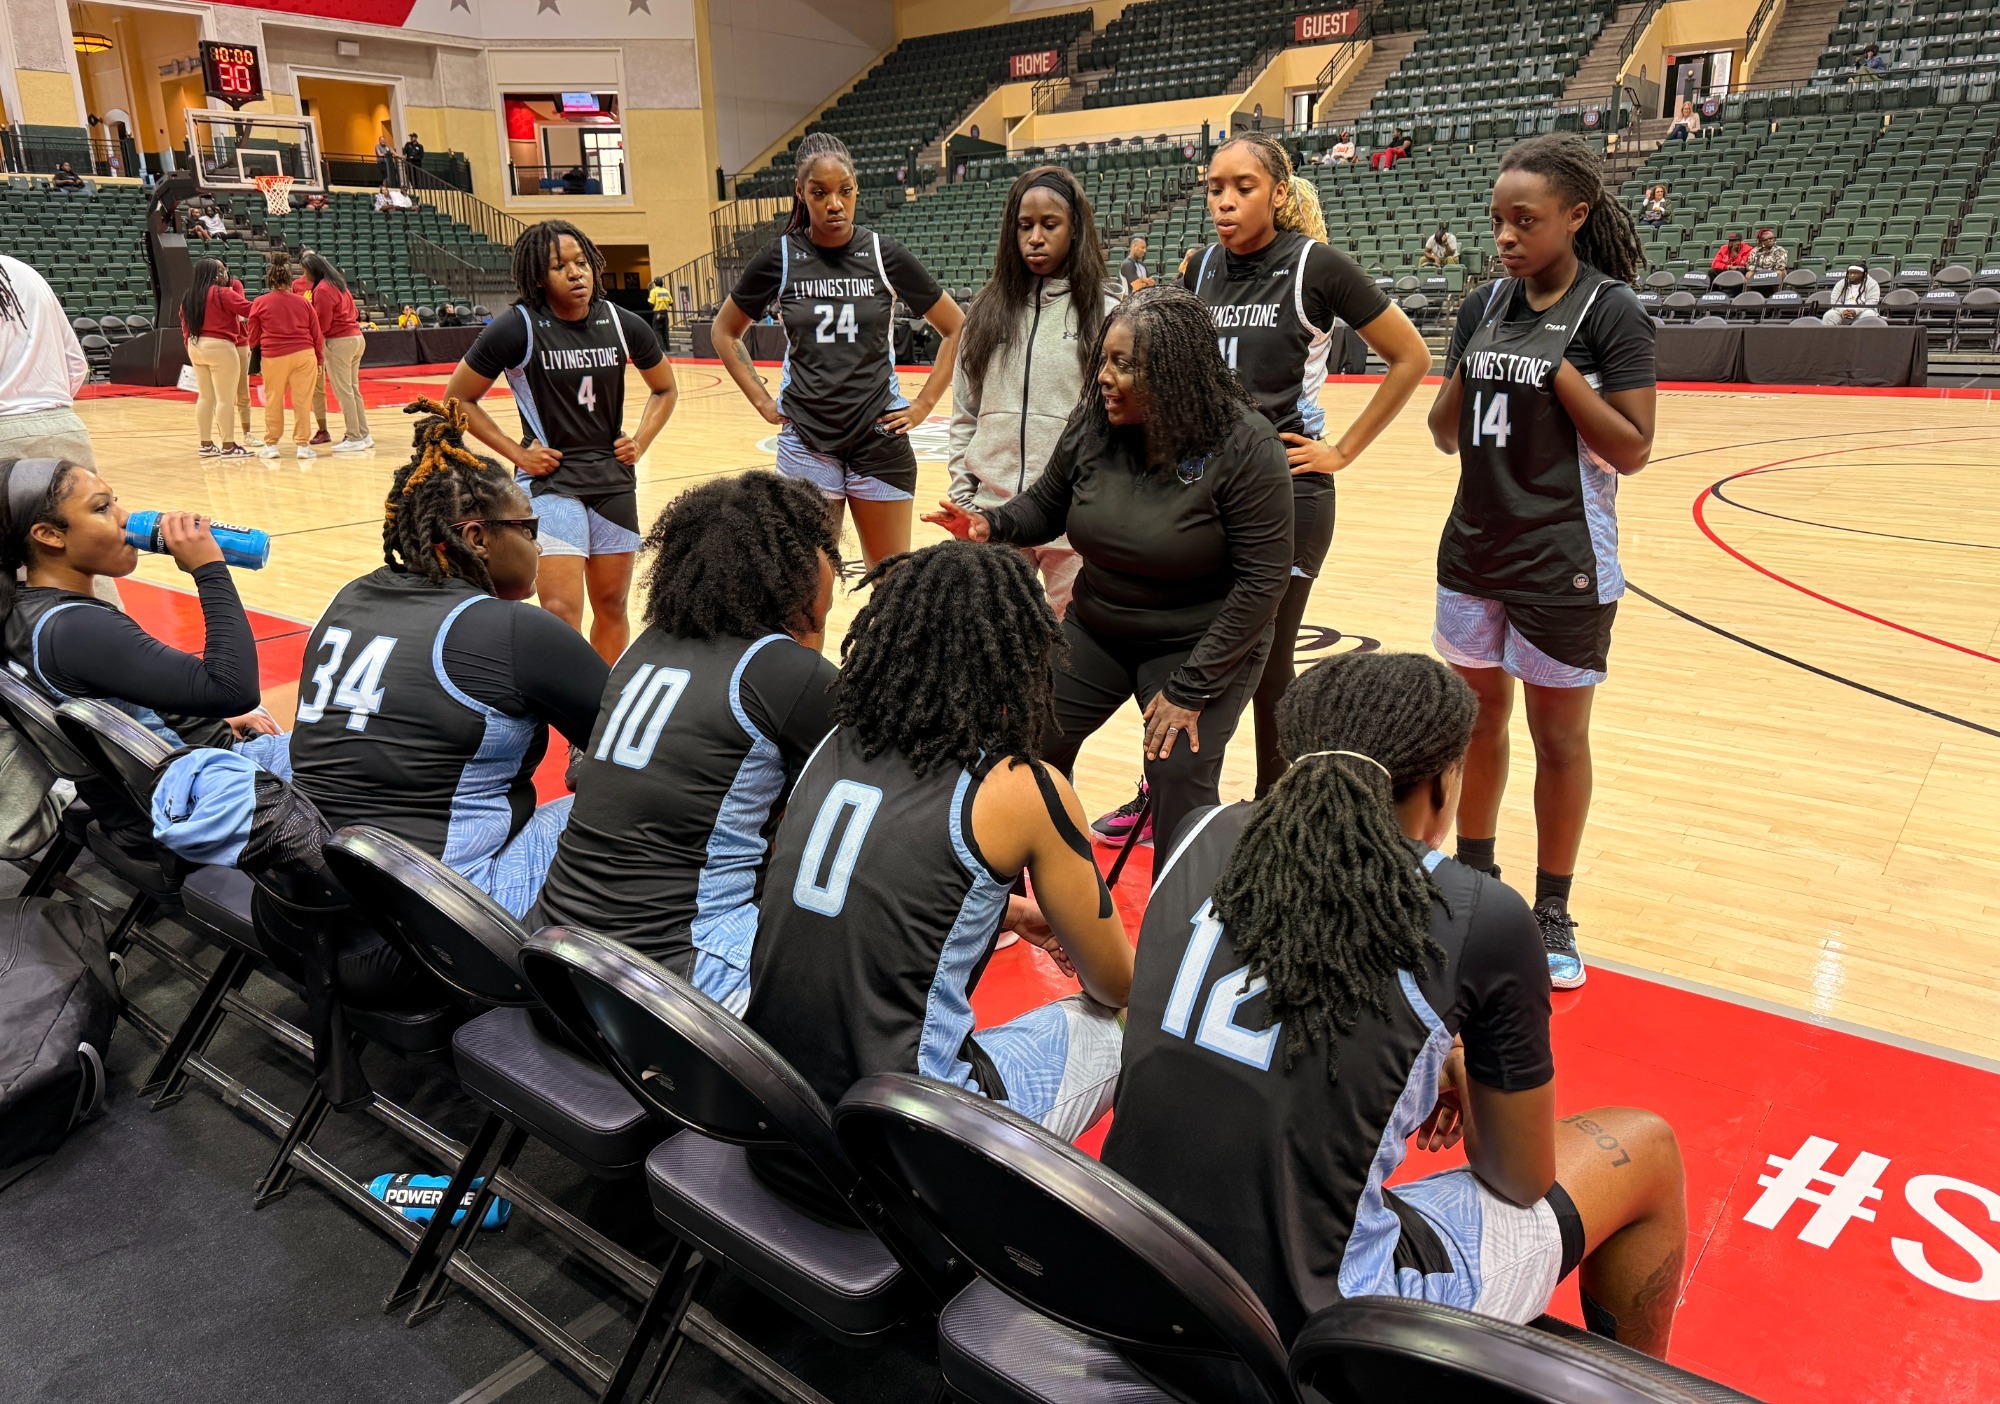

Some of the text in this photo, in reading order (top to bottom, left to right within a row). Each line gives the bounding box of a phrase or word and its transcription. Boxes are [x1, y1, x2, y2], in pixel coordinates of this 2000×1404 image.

[1302, 11, 1350, 38] GUEST
[214, 47, 254, 66] 10:00
[1015, 52, 1051, 76] HOME
[218, 63, 252, 93] 30
[793, 278, 875, 300] LIVINGSTONE
[1753, 272, 1778, 280] RESERVED
[1926, 291, 1955, 299] RESERVED
[813, 303, 859, 344] 24
[541, 346, 619, 370] LIVINGSTONE
[577, 375, 597, 412] 4
[1472, 390, 1512, 448] 14
[296, 626, 399, 732] 34
[594, 663, 691, 770] 10
[792, 779, 884, 917] 0
[1160, 896, 1283, 1072] 12
[385, 1189, 475, 1206] POWERE
